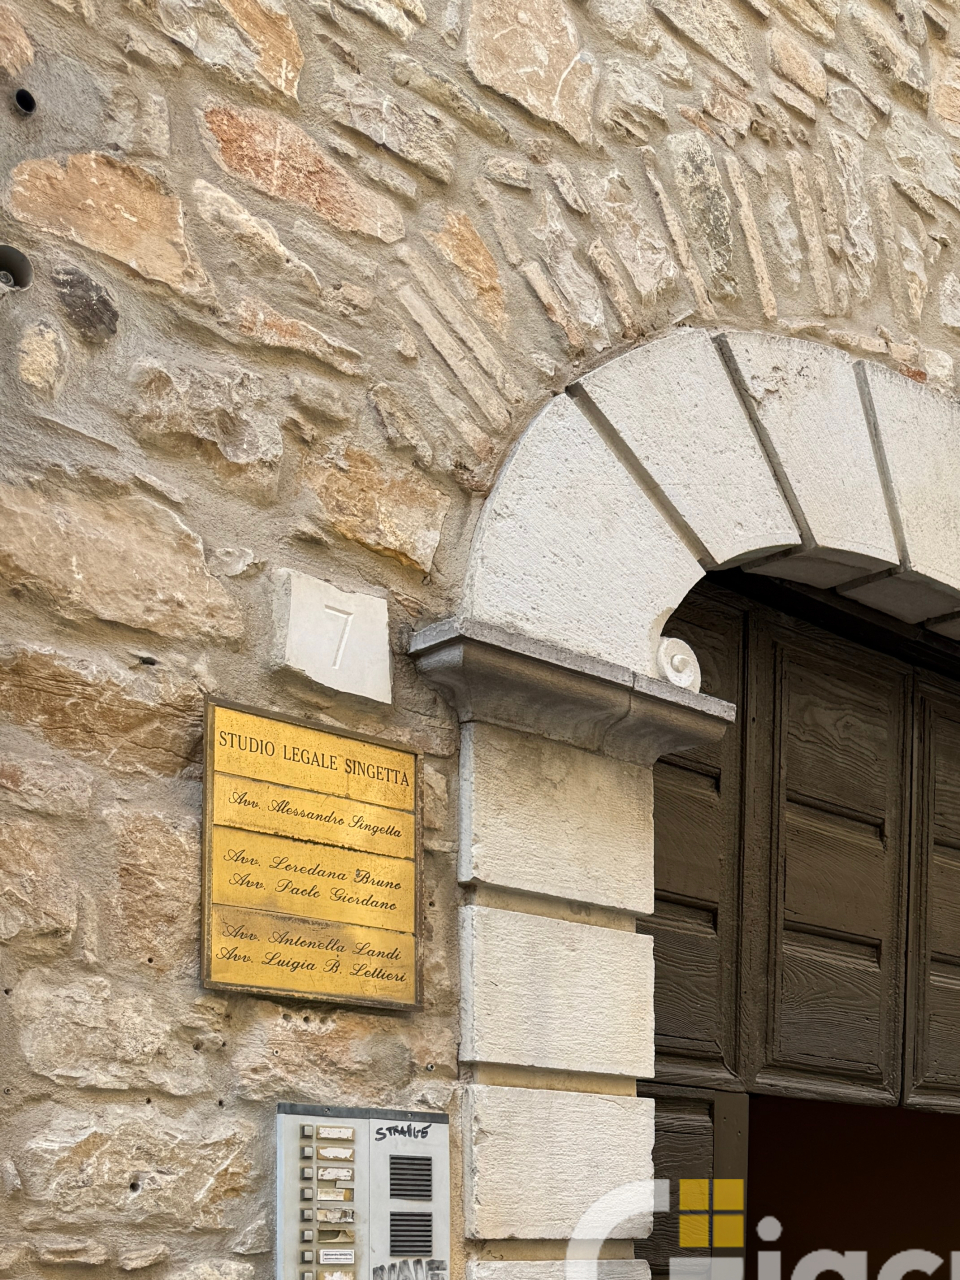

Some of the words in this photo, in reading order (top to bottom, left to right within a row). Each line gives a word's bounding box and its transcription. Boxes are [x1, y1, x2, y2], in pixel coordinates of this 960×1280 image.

[324, 604, 354, 669] 7
[219, 731, 275, 757] STUDIO
[283, 745, 338, 771] LEGALE
[344, 759, 410, 787] SINGETTA
[228, 791, 261, 810] Avv.
[267, 799, 345, 826] Alessandro
[347, 815, 402, 838] Singetta
[223, 849, 261, 867] Avv.
[269, 856, 348, 881] Loredana
[353, 868, 402, 890] Bruno
[228, 873, 266, 890] Avv.
[275, 878, 321, 899] Paolo
[329, 887, 397, 911] Giordano
[221, 924, 260, 942] Avv.
[267, 931, 347, 953] Antonella
[351, 942, 402, 961] Landi
[215, 947, 253, 963] Avv.
[261, 952, 317, 973] Luigia
[349, 963, 407, 983] Lettieri
